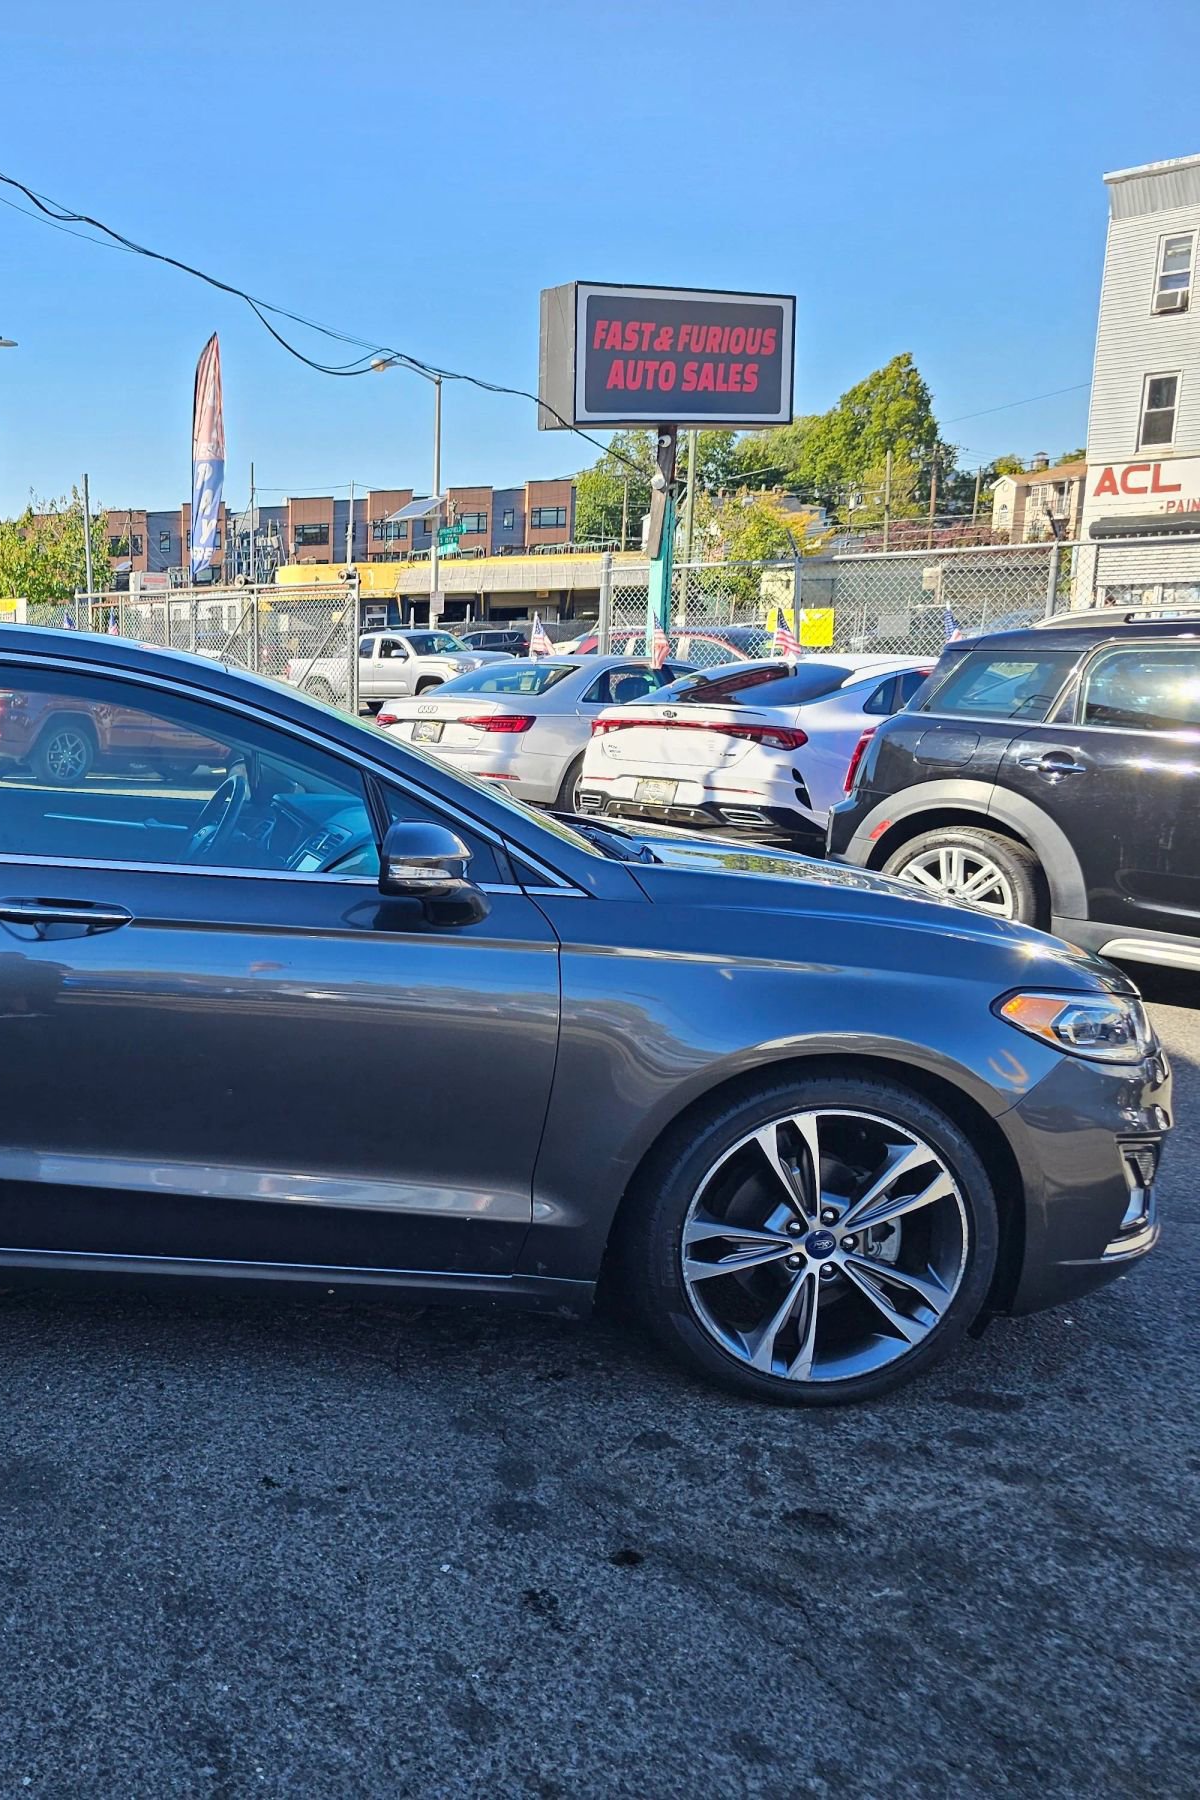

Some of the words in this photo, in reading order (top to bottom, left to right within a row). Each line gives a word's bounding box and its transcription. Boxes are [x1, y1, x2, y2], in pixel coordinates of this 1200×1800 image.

[677, 324, 777, 356] FURIOUS
[606, 360, 677, 391] AUTO
[681, 361, 759, 392] SALES
[1093, 463, 1182, 497] ACL
